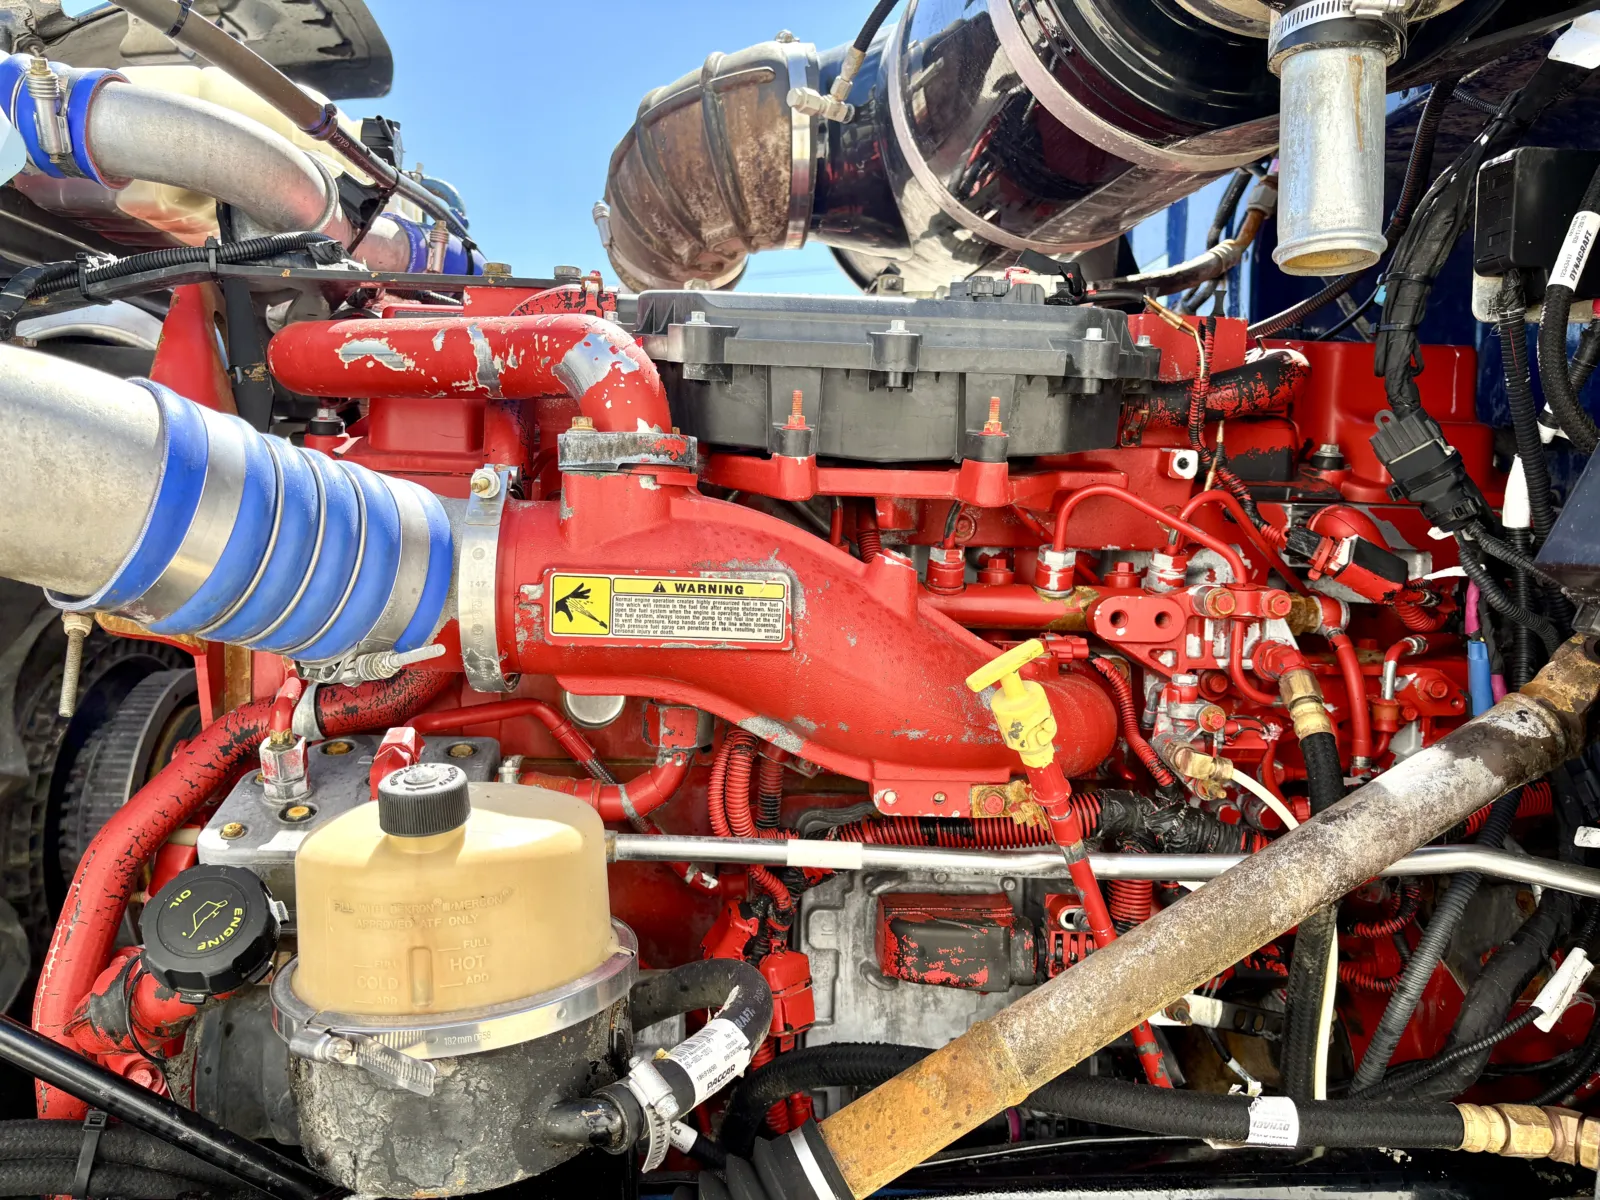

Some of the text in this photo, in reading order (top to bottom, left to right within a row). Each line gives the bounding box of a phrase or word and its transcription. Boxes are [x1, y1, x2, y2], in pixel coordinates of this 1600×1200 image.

[1569, 230, 1592, 282] DYNACRAFT
[674, 583, 744, 595] WARNING
[169, 889, 192, 909] OIL
[197, 907, 243, 951] ENGINE
[356, 914, 478, 930] APPROVED ATF ONLY
[463, 938, 490, 948] FULL
[450, 954, 485, 972] HOT
[357, 975, 399, 990] COLD
[466, 972, 489, 985] ADD
[377, 996, 398, 1005] ADD
[444, 1035, 472, 1046] 182mm
[707, 1064, 736, 1090] PACCAR
